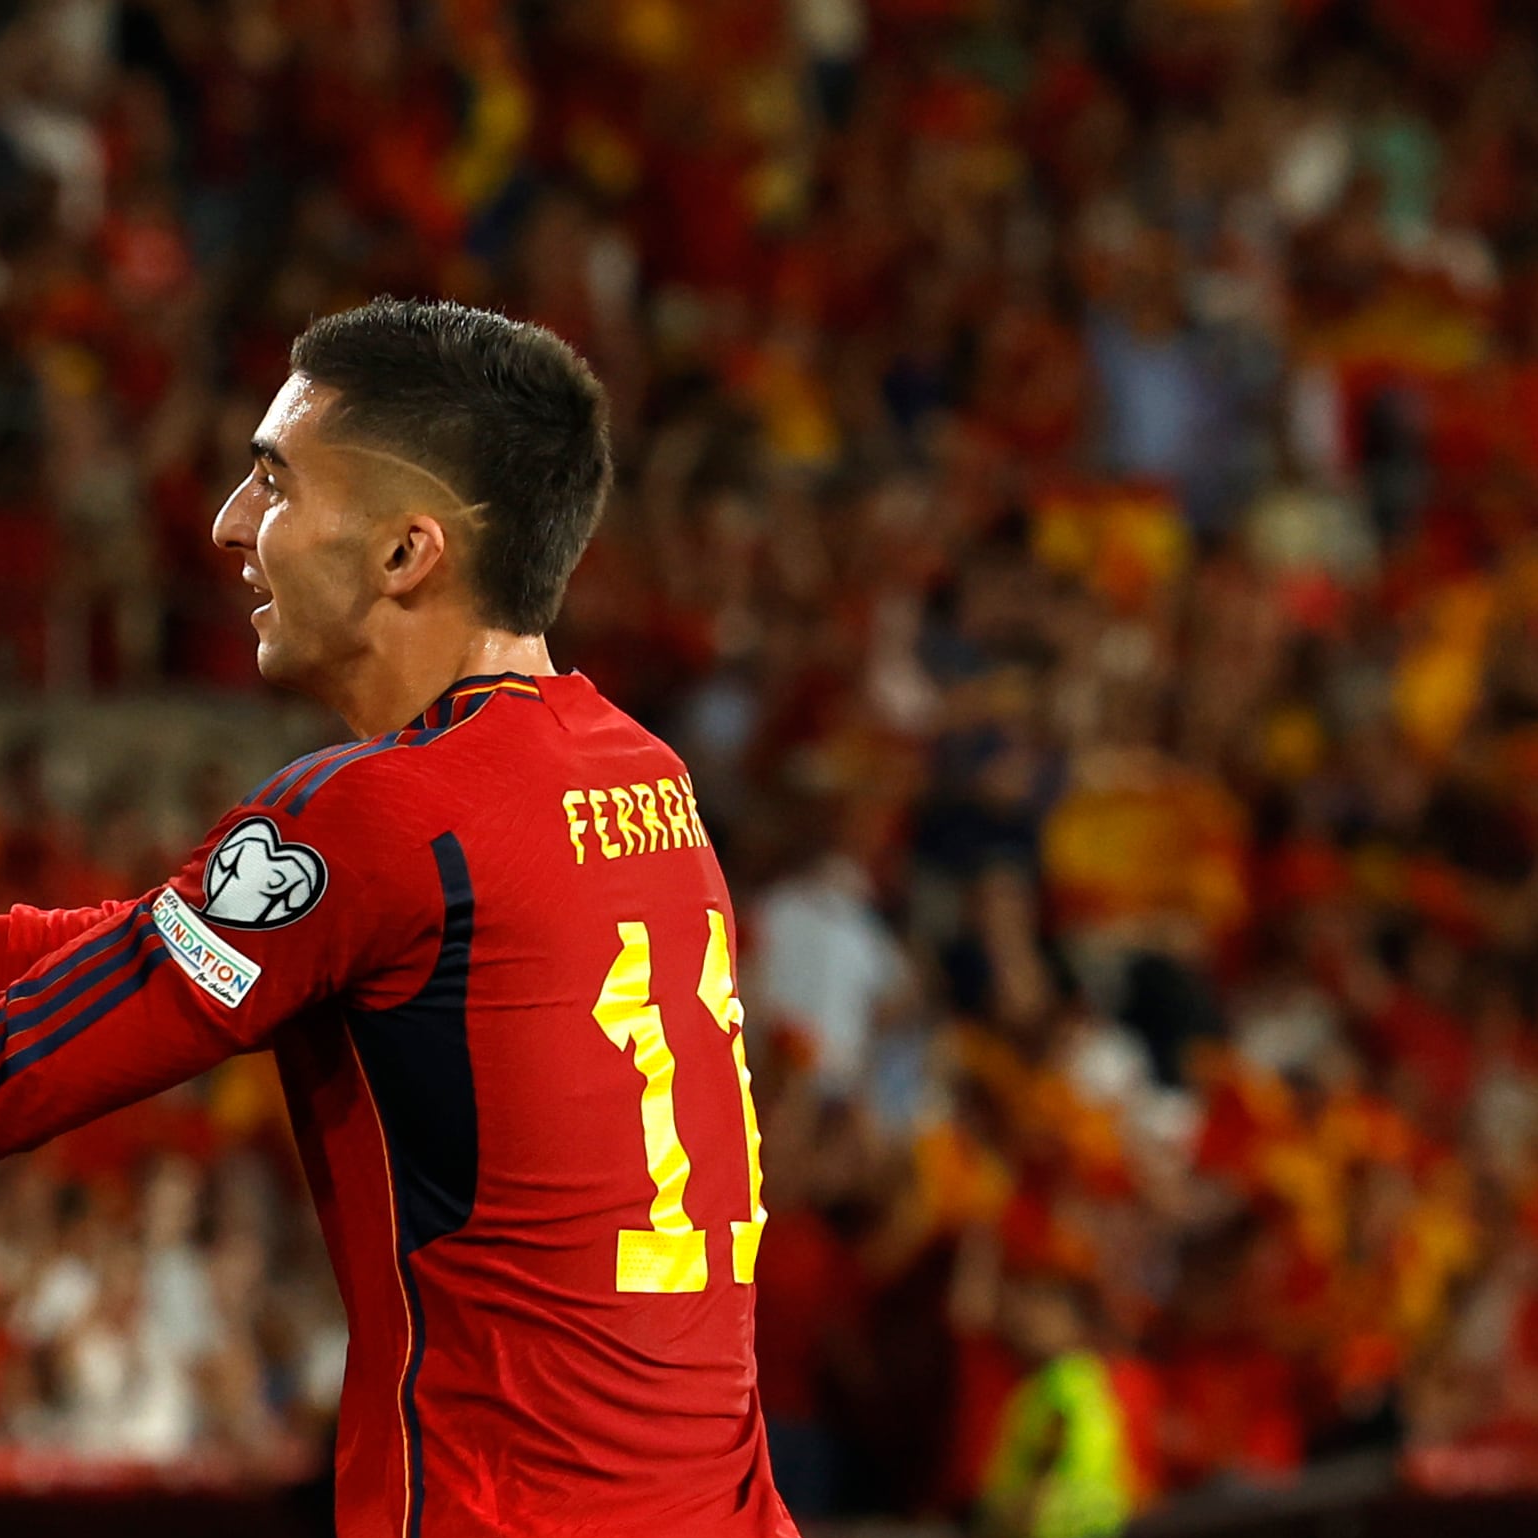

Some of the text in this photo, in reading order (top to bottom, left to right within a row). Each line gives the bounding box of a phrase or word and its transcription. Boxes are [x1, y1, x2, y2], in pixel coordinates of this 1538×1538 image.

[561, 773, 709, 865] FERRAN
[151, 900, 250, 993] FOUNDATION
[207, 980, 236, 1004] children
[591, 908, 768, 1293] 11
